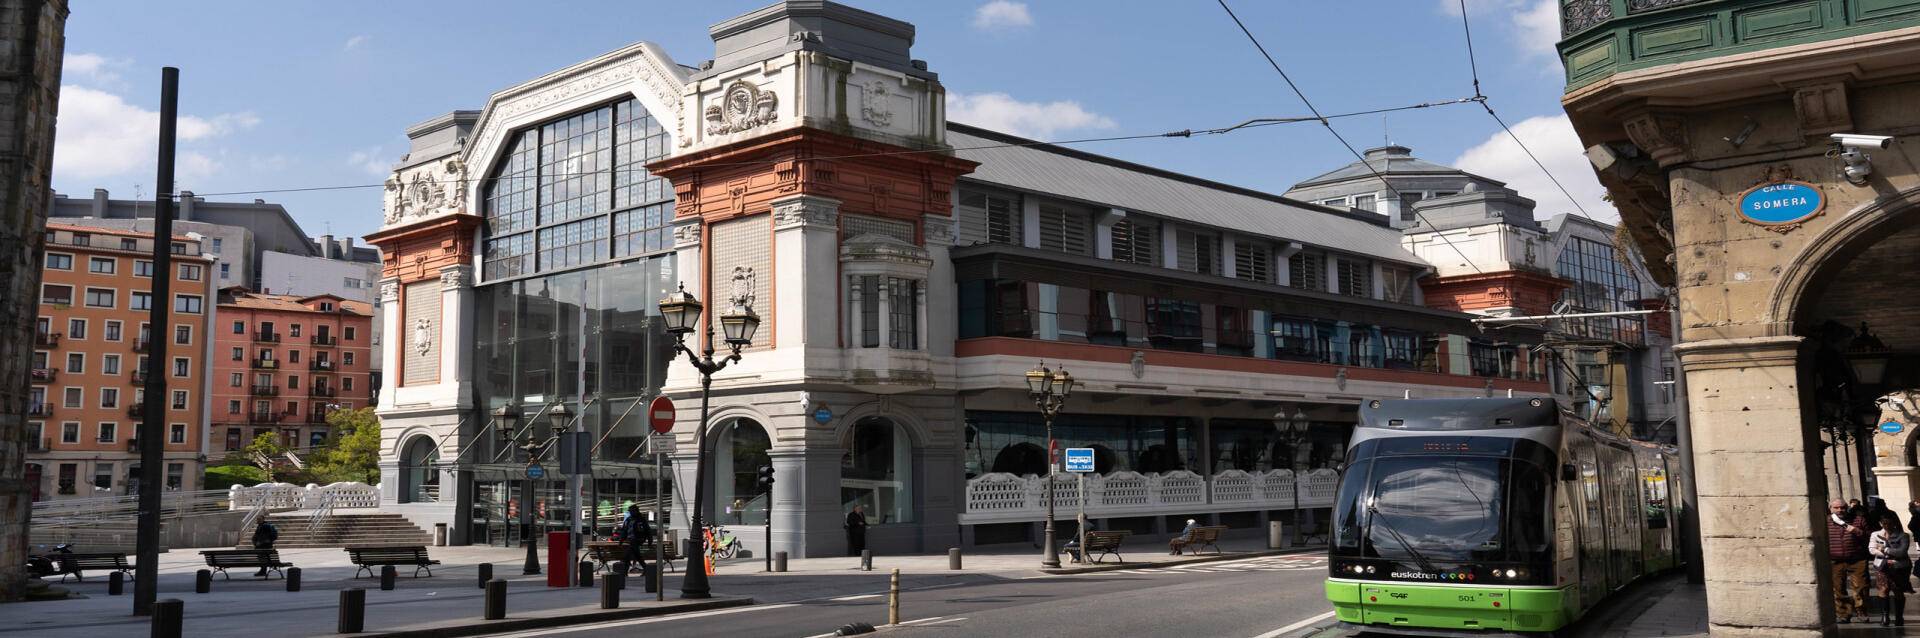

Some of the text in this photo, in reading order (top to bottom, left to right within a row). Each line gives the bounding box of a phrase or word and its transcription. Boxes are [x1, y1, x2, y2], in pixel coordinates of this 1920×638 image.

[1762, 184, 1795, 193] CALLE
[1753, 197, 1807, 210] SOMERA
[1391, 571, 1438, 580] euskotren
